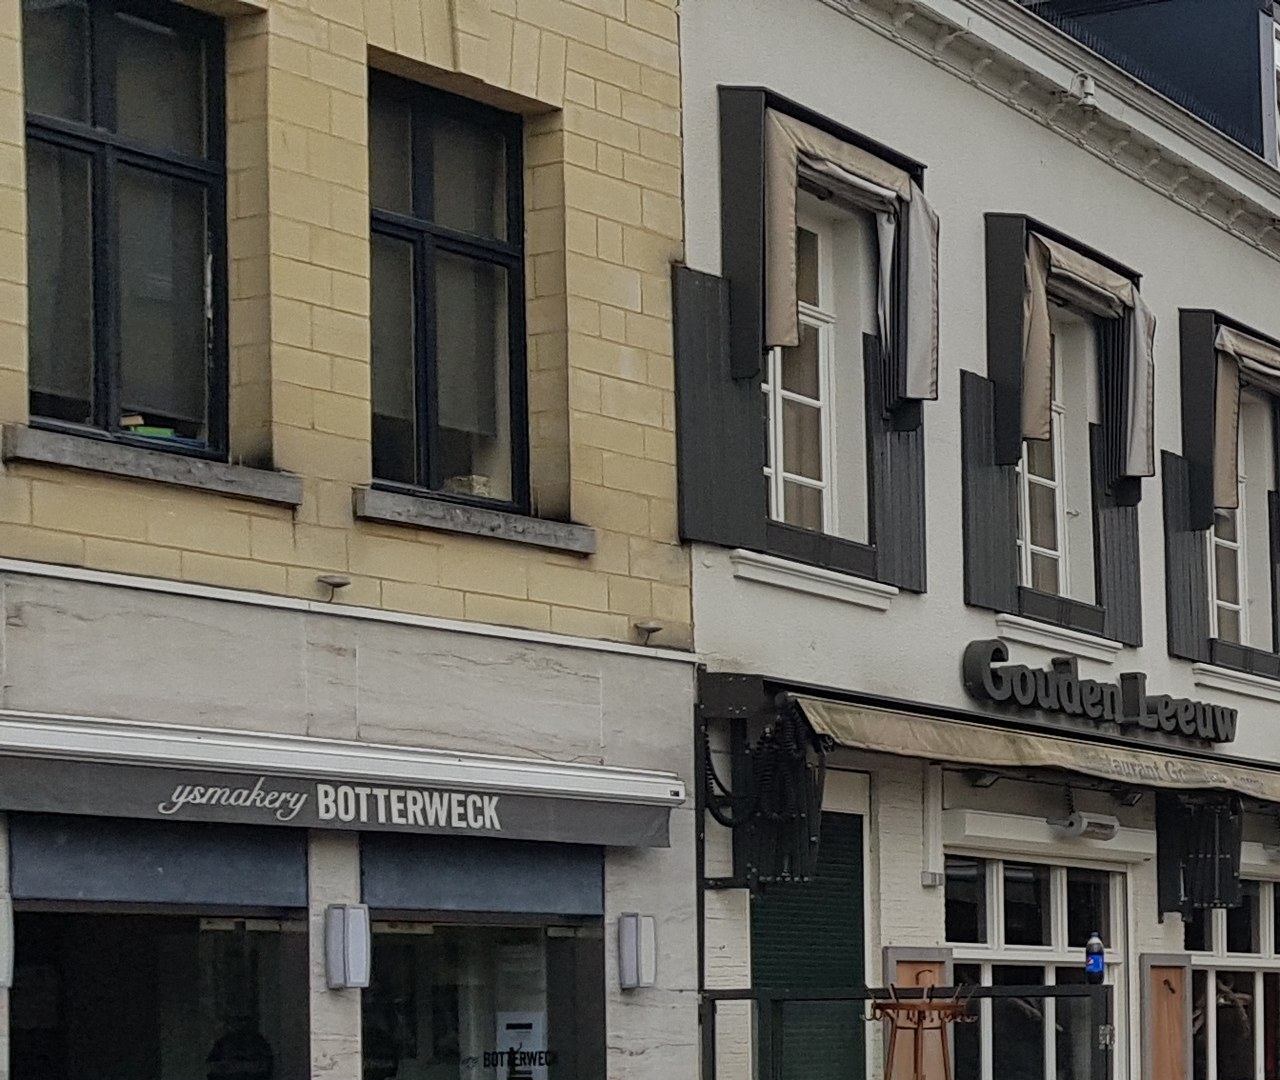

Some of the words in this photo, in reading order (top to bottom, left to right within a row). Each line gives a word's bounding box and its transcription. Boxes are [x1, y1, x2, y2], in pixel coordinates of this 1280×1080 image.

[1120, 672, 1238, 742] Leeuw
[316, 783, 501, 830] BOTTERWECK
[483, 1051, 558, 1068] BOTTERWEC
